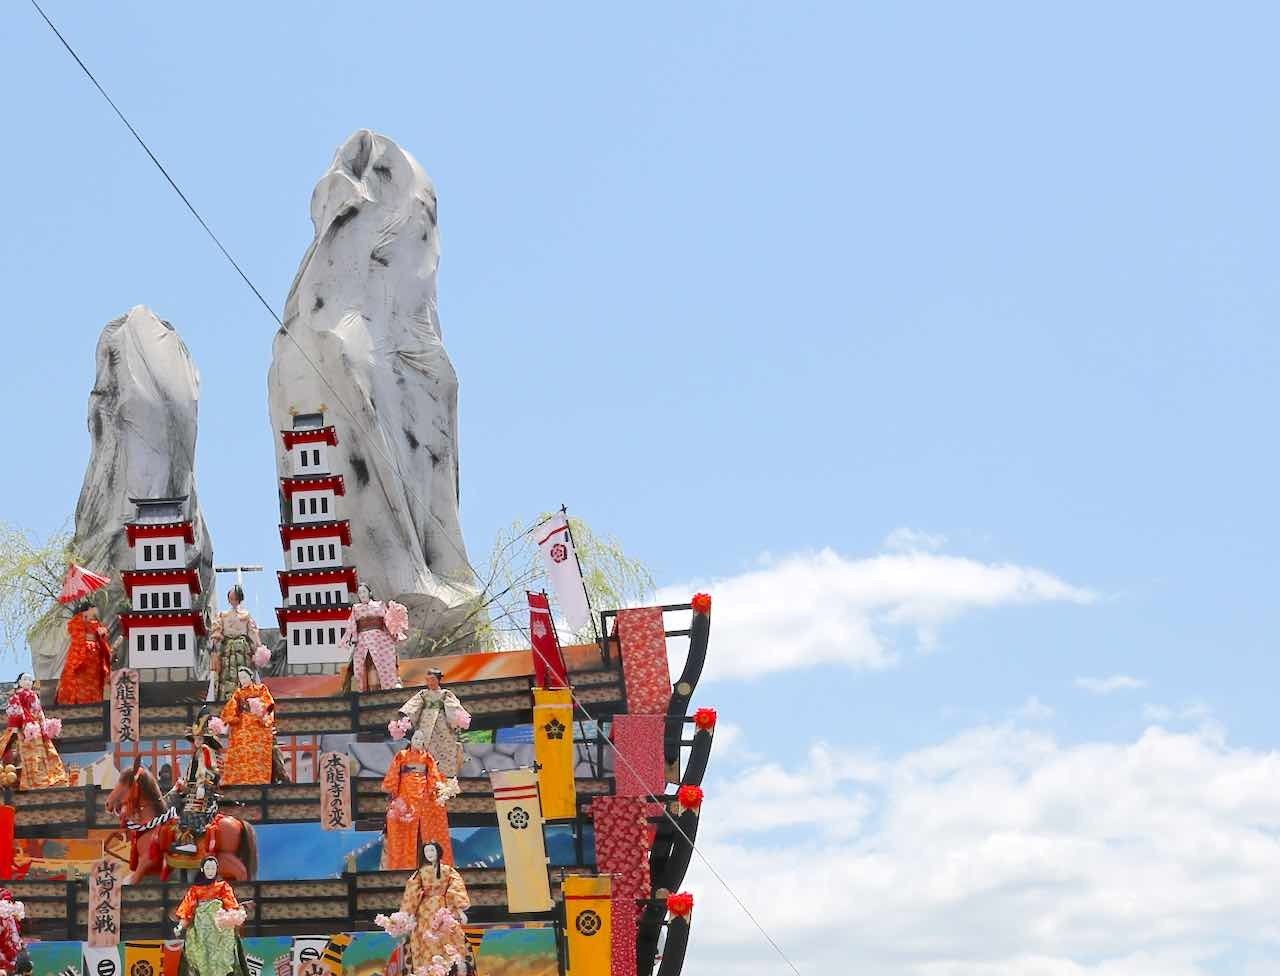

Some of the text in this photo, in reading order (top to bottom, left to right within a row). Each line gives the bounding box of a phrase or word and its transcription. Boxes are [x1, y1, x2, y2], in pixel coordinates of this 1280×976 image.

[324, 753, 347, 828] 本能寺の変
